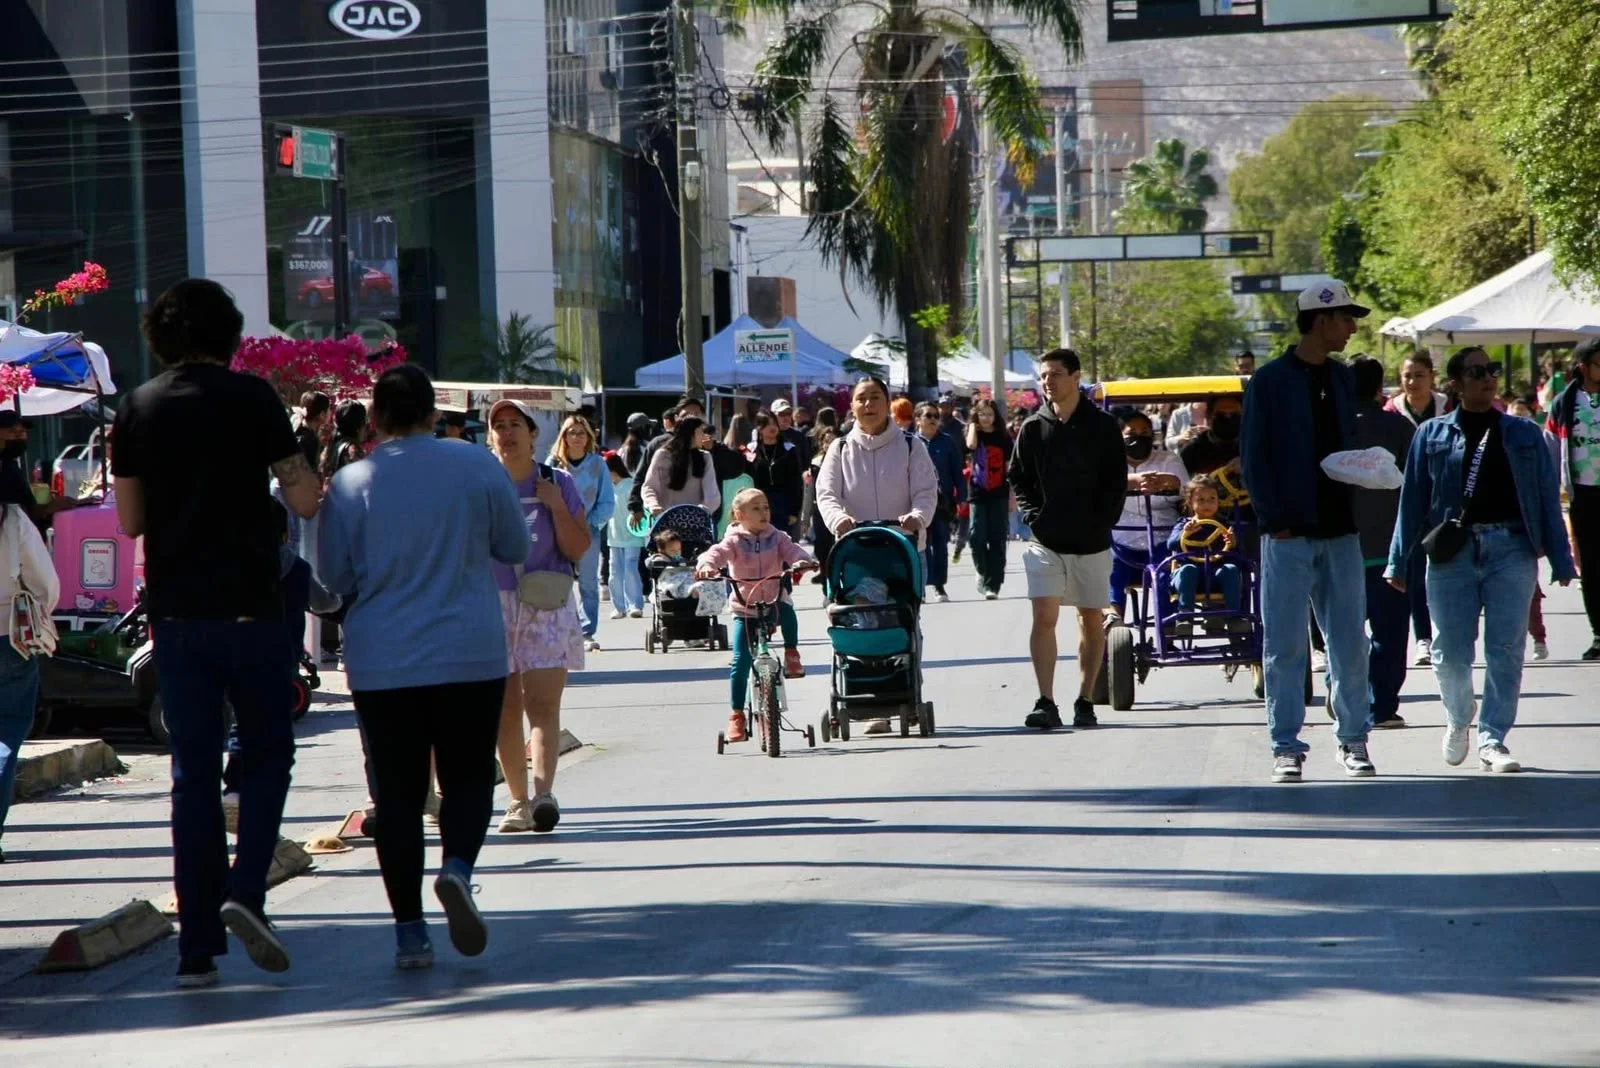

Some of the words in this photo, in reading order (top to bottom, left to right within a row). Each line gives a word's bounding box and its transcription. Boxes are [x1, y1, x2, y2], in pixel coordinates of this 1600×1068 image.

[347, 6, 406, 26] JAC
[297, 216, 332, 236] J7
[739, 343, 788, 352] ALLENDE
